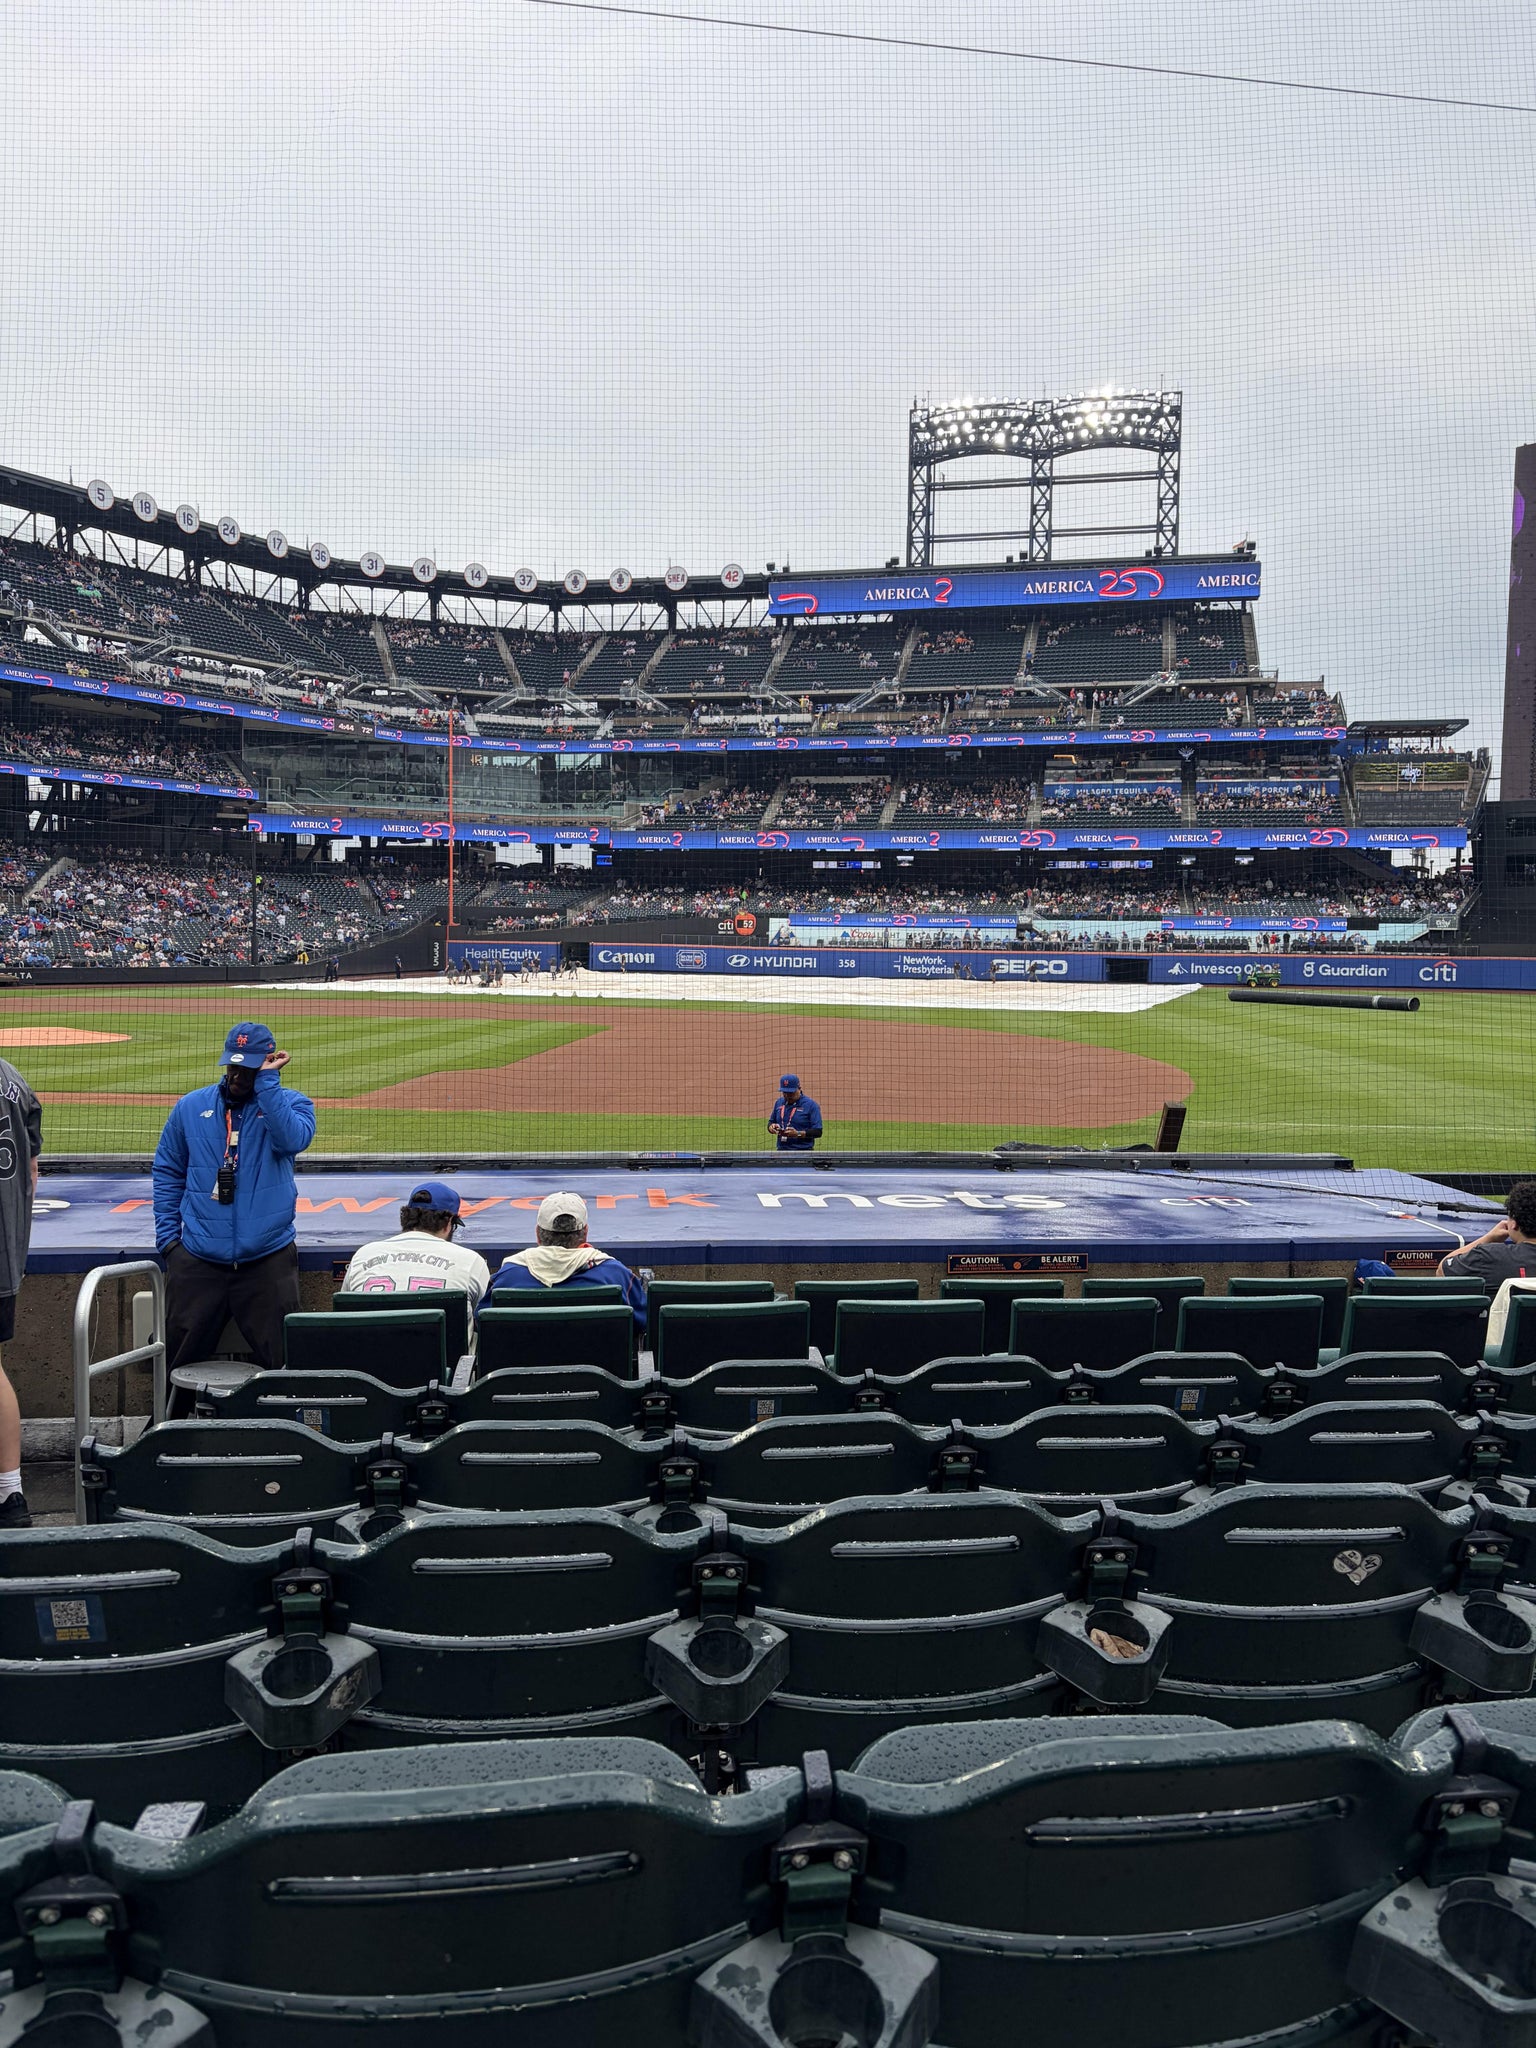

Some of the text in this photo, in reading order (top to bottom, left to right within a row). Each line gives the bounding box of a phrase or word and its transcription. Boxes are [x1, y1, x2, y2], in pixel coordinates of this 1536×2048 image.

[97, 487, 105, 502] 5
[139, 499, 151, 514] 18
[182, 511, 193, 526] 16
[222, 523, 236, 538] 24
[272, 537, 283, 550] 17
[315, 550, 327, 562] 36
[367, 558, 378, 571] 31
[419, 564, 430, 576] 41
[471, 570, 481, 581] 14
[519, 574, 533, 587] 37
[725, 571, 739, 583] 42
[864, 577, 953, 603] AMERICA 2
[1023, 580, 1094, 594] AMERICA
[4, 669, 33, 679] AMERICA
[73, 681, 100, 690] AMERICA
[135, 691, 162, 700] AMERICA
[196, 700, 220, 709] AMERICA
[250, 709, 272, 718] AMERICA
[300, 717, 322, 726] AMERICA
[1261, 786, 1289, 794] PORCH
[290, 821, 329, 829] AMERICA
[382, 825, 420, 833] AMERICA
[472, 829, 507, 837] AMERICA
[554, 831, 588, 839] AMERICA
[1167, 834, 1209, 842] AMERICA
[1265, 834, 1308, 842] AMERICA
[1367, 833, 1409, 842] AMERICA
[637, 836, 671, 844] AMERICA
[719, 836, 755, 844] AMERICA
[805, 836, 840, 844] AMERICA
[890, 836, 927, 844] AMERICA
[978, 835, 1018, 843] AMERICA
[1073, 835, 1112, 843] AMERICA
[718, 919, 734, 930] citi
[743, 920, 754, 928] 52
[851, 928, 876, 939] Coors
[465, 947, 540, 961] HealthEquity
[598, 950, 655, 964] Canon
[753, 956, 817, 968] HYUNDAI
[839, 959, 856, 968] 358
[903, 956, 946, 965] NewYork-
[991, 959, 1068, 974] GEICO
[1190, 962, 1242, 975] Invesco
[1319, 964, 1388, 977] Guardian
[1419, 960, 1457, 982] citi
[756, 1190, 1068, 1209] mets
[1159, 1195, 1255, 1208] citi
[960, 1256, 999, 1265] CAUTION!
[1053, 1255, 1080, 1263] ALERT!
[1396, 1252, 1433, 1260] CAUTION!
[362, 1252, 455, 1271] NEW YORK CITY
